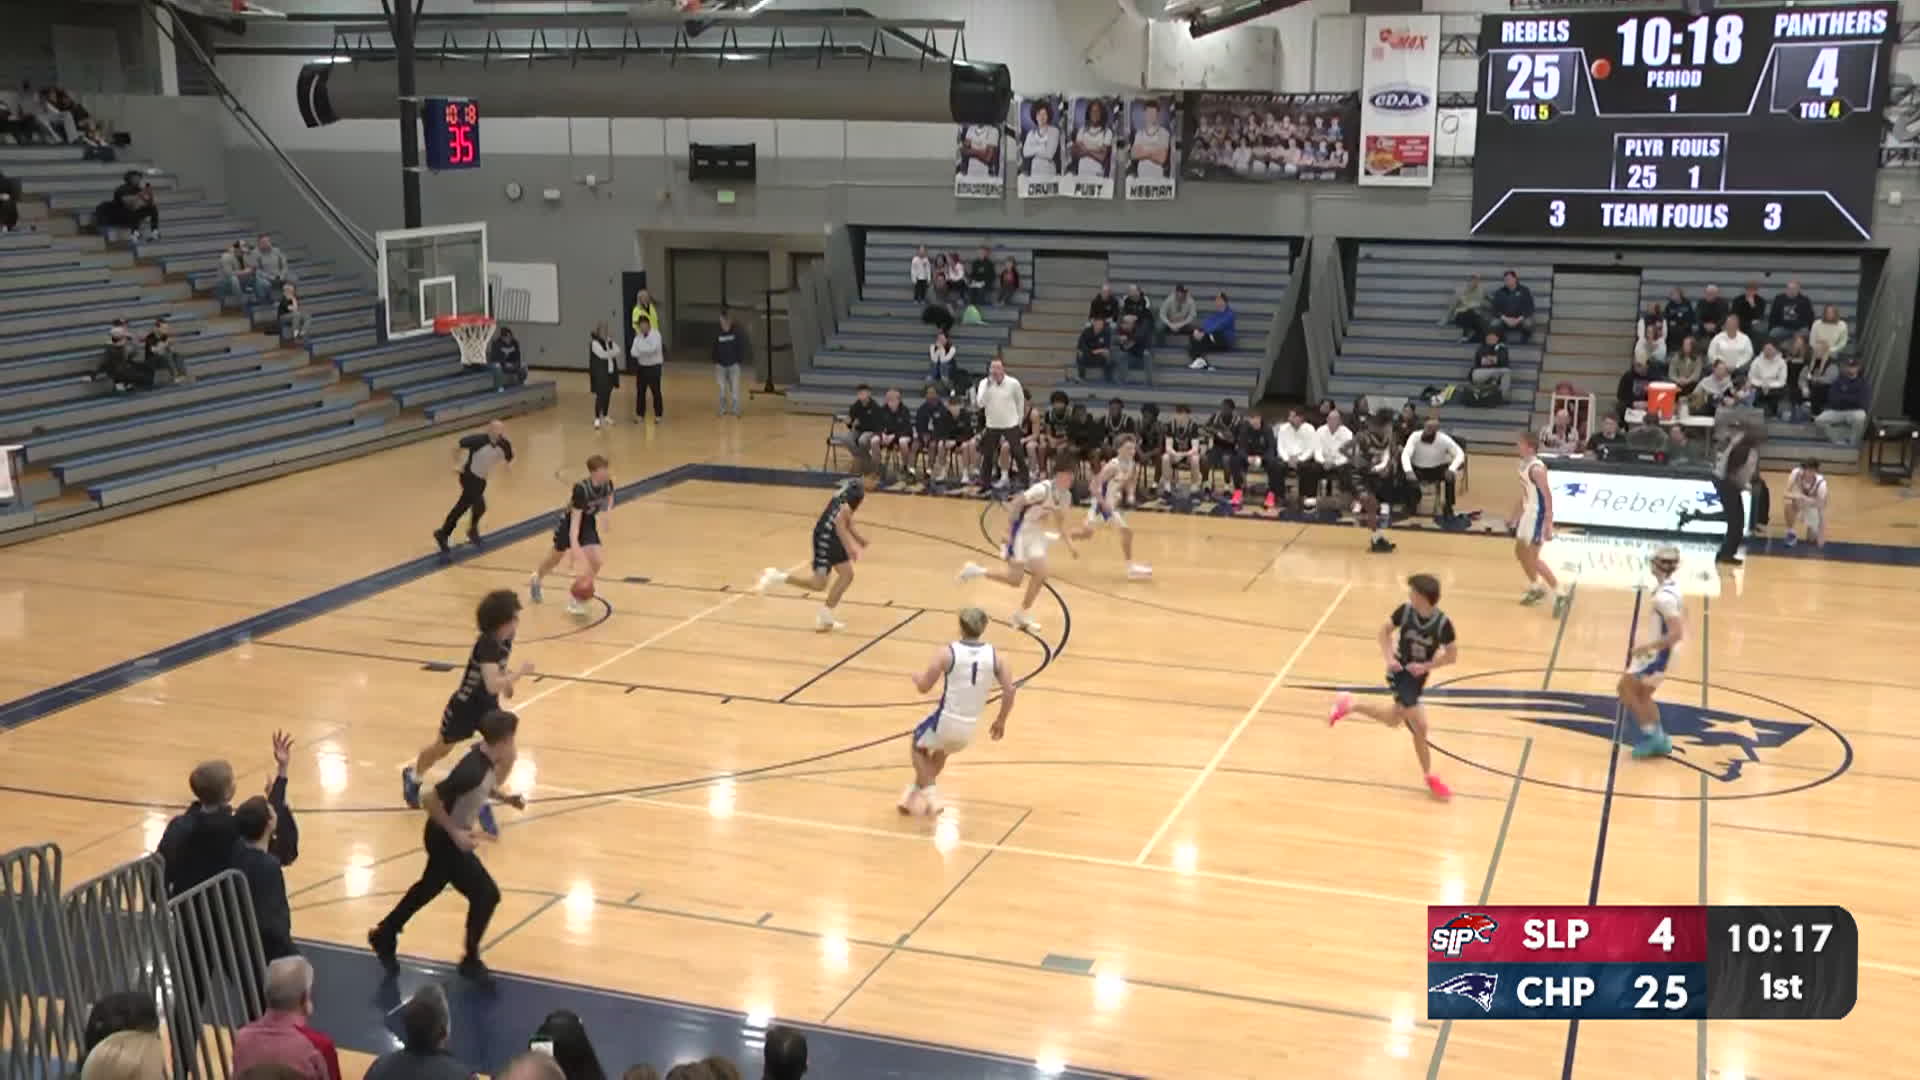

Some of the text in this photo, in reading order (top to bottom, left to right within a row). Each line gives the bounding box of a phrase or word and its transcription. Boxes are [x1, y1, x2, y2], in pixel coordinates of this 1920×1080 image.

[1502, 20, 1570, 43] REBELS
[1774, 9, 1888, 37] PANTHERS
[1617, 15, 1743, 66] 10:18
[1506, 54, 1561, 100] 25
[1647, 70, 1702, 88] PERIOD
[1806, 47, 1839, 96] 4
[1513, 104, 1548, 120] TOL 5
[1669, 94, 1676, 112] 1
[1800, 102, 1839, 118] TOL 4
[448, 126, 473, 163] 35
[1625, 138, 1720, 157] PLYR FOULS
[1627, 165, 1699, 189] 25 1
[1550, 200, 1565, 227] 3
[1601, 203, 1728, 228] TEAM FOULS
[1764, 203, 1782, 230] 3
[1590, 488, 1690, 515] Rebels
[971, 661, 978, 686] 1
